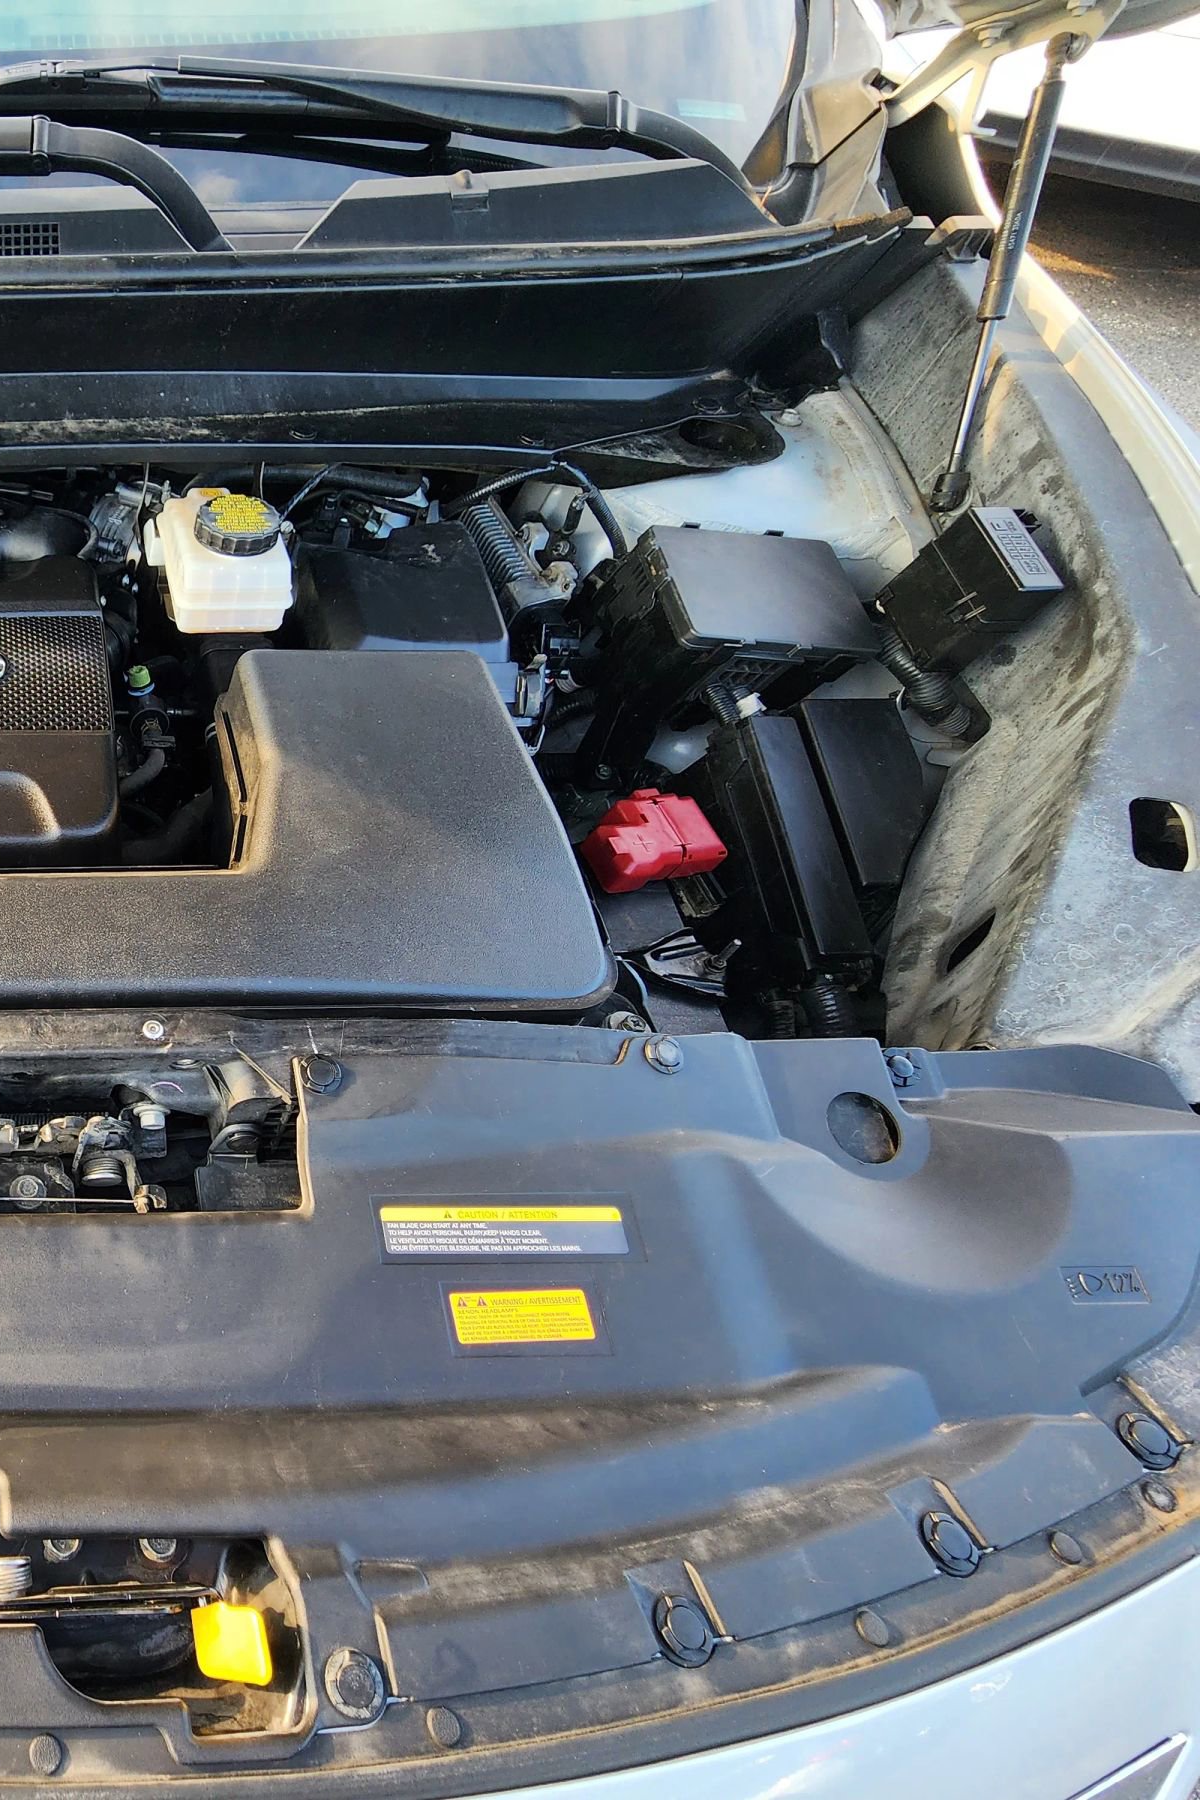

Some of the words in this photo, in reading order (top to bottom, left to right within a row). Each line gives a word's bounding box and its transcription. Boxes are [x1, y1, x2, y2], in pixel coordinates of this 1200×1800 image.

[457, 1210, 499, 1219] CAUTION
[508, 1210, 558, 1219] ATTENTION
[490, 1298, 524, 1306] WARNING
[529, 1296, 580, 1304] AVERTISSEMENT
